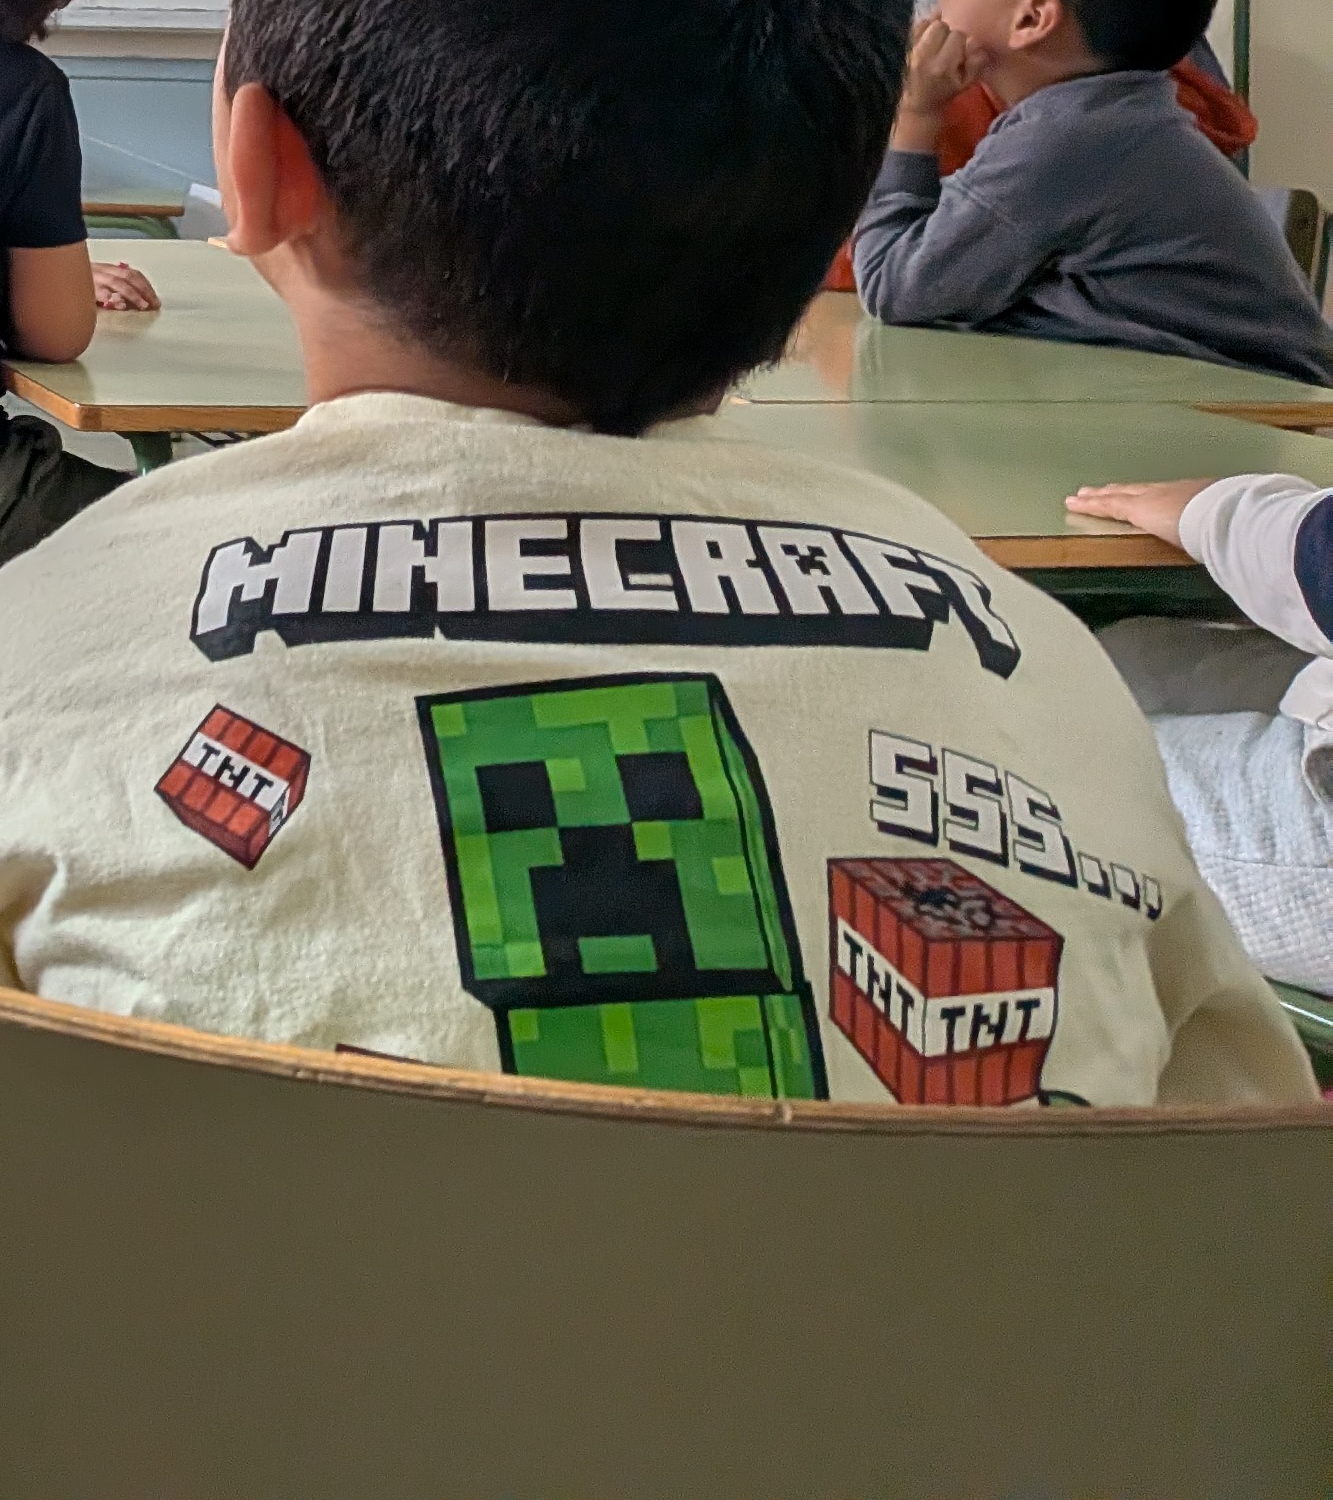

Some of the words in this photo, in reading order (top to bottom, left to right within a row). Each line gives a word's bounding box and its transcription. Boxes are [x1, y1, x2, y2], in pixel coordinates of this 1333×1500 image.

[190, 512, 1021, 680] MINECRAFT
[198, 741, 275, 800] TNT
[843, 930, 915, 1042] TNT
[939, 997, 1041, 1055] TNT
